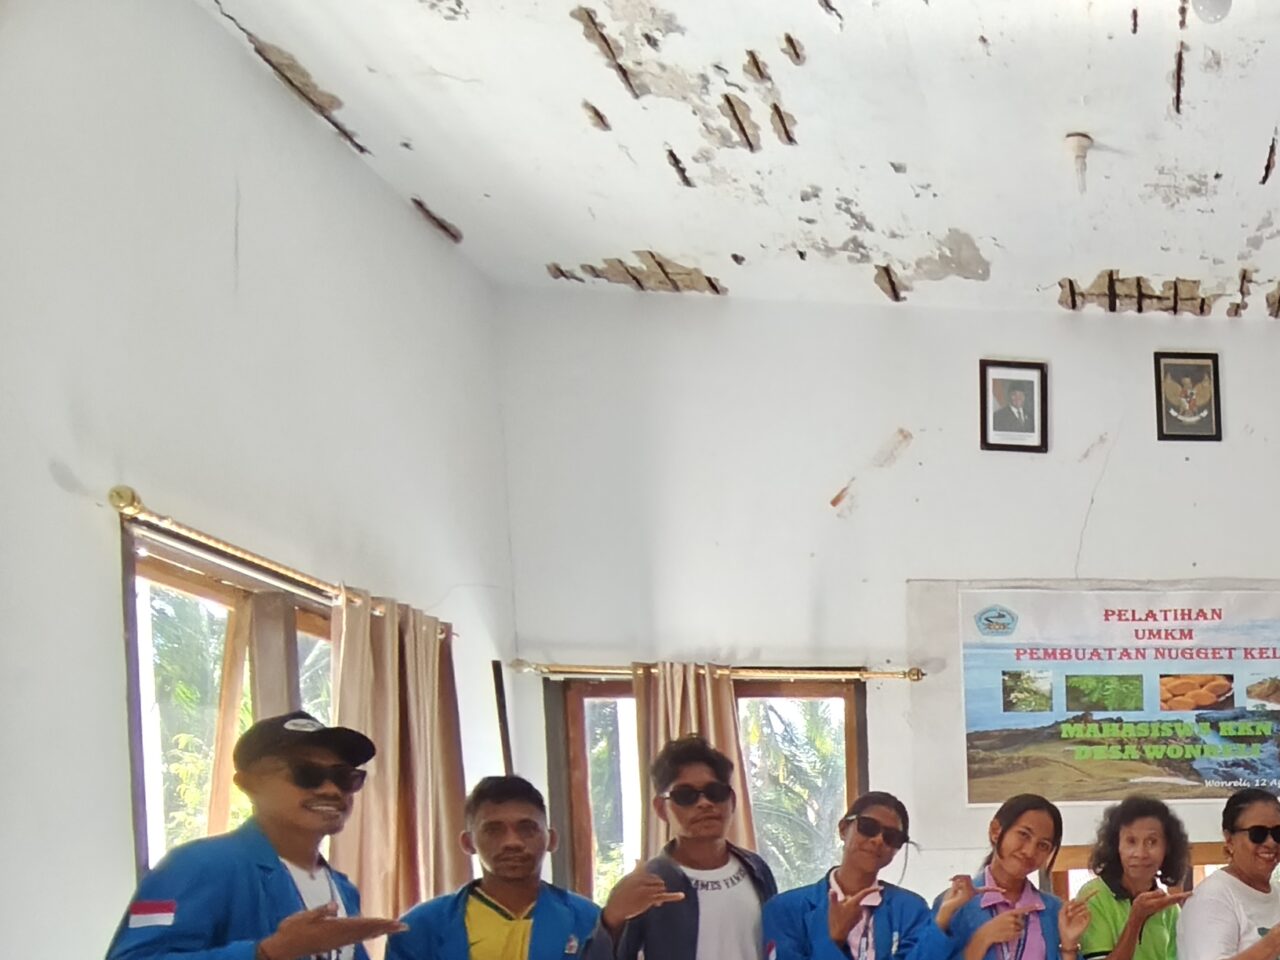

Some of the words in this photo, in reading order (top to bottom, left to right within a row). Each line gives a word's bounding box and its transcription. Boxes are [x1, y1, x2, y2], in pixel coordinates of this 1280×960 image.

[1103, 608, 1222, 622] PELATIHAN
[1133, 628, 1194, 641] UMKM
[1014, 647, 1147, 661] PEMBUATAN
[1154, 647, 1238, 661] NUGGET
[1073, 744, 1140, 761] DESA
[1254, 778, 1268, 786] 12
